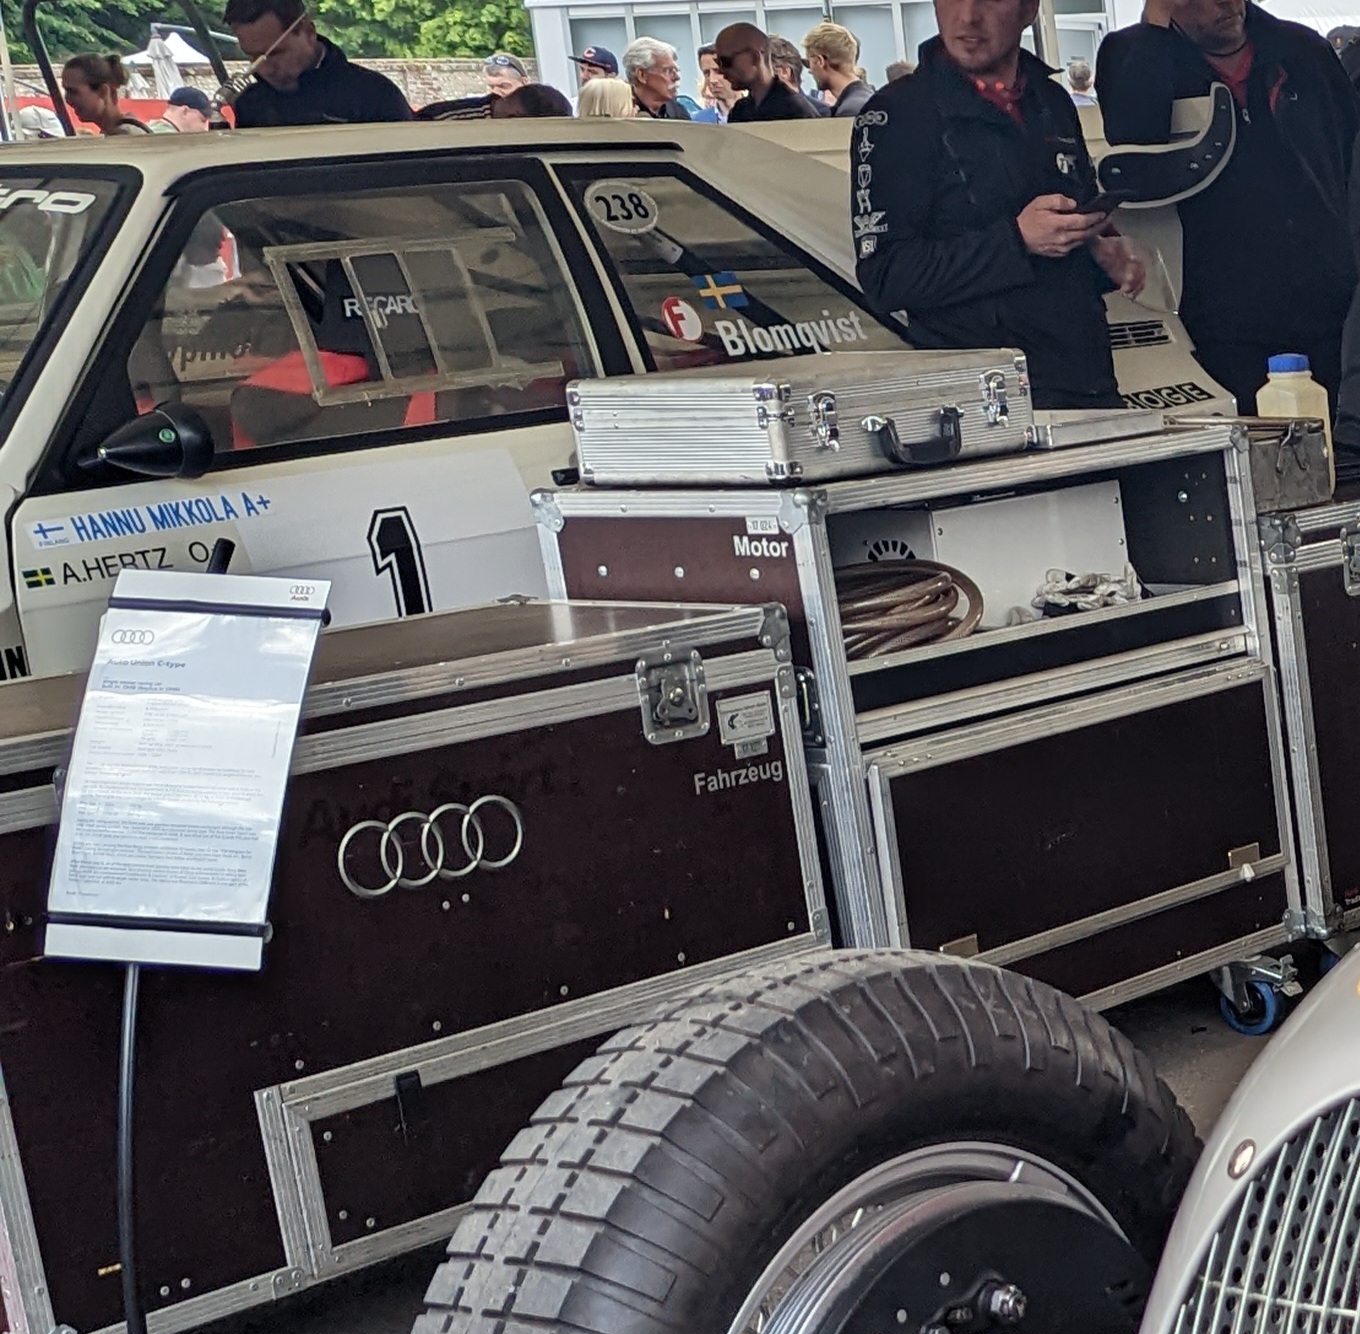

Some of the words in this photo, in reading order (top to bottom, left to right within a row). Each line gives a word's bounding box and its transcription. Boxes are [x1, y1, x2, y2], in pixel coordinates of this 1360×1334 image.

[0, 184, 96, 214] ro
[595, 193, 650, 223] 238
[343, 295, 419, 318] RCAR
[714, 309, 869, 358] Blomqvist
[70, 508, 147, 543] HANNU
[146, 495, 240, 532] MIKKOLA
[241, 491, 272, 518] A+
[188, 540, 216, 564] O
[732, 534, 789, 558] Motor
[367, 505, 433, 618] 1
[693, 760, 784, 796] Fahrzeug
